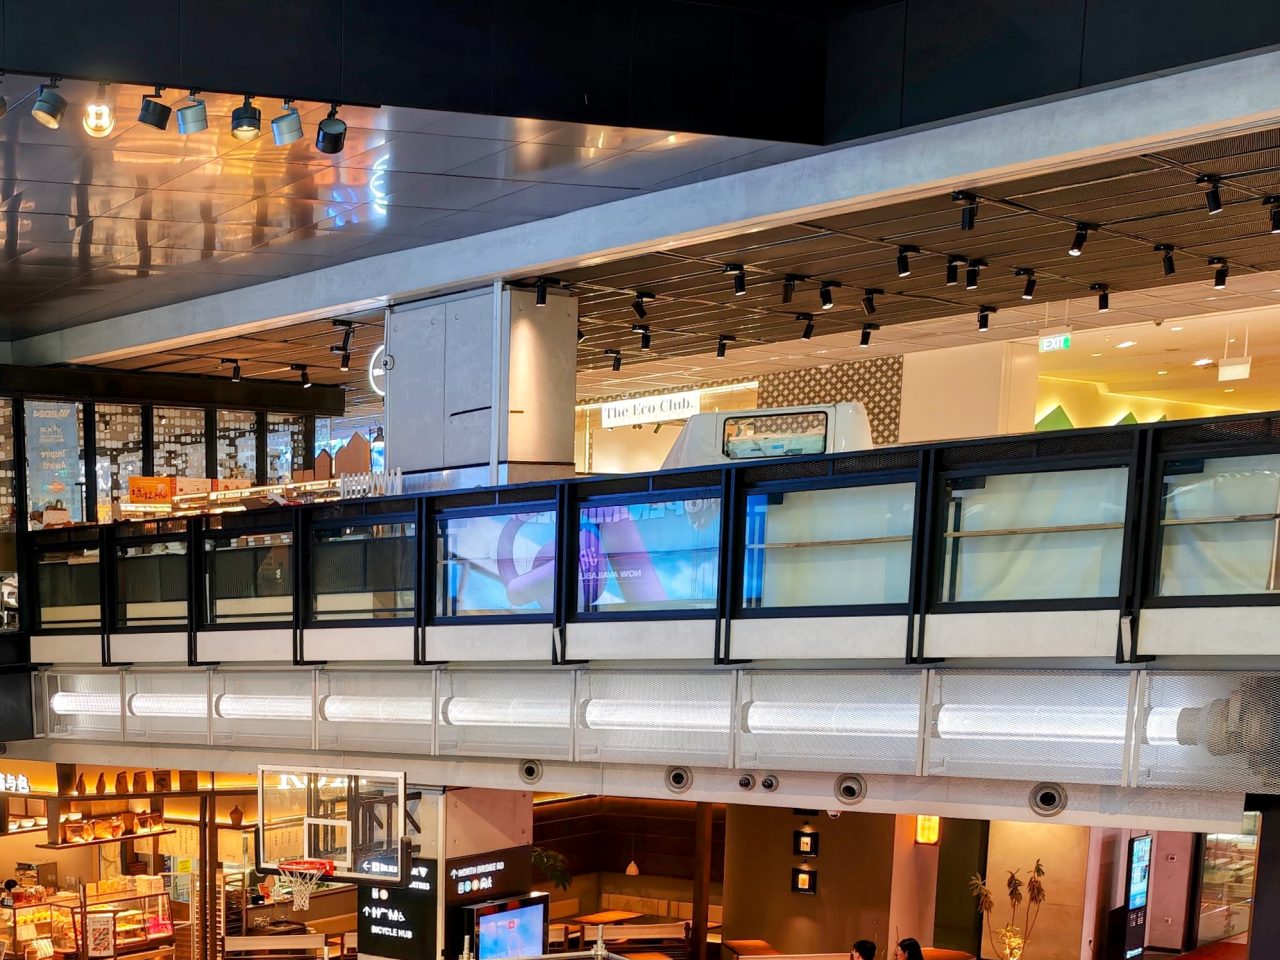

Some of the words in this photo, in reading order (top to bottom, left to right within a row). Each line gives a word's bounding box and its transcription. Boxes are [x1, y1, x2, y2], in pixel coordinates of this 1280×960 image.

[1043, 336, 1066, 351] EXIT
[605, 407, 628, 419] The
[633, 403, 655, 416] Eco
[457, 867, 476, 878] NORTH
[477, 863, 494, 874] BRIDGE
[371, 925, 397, 937] BICYCLE
[398, 929, 413, 939] HUB
